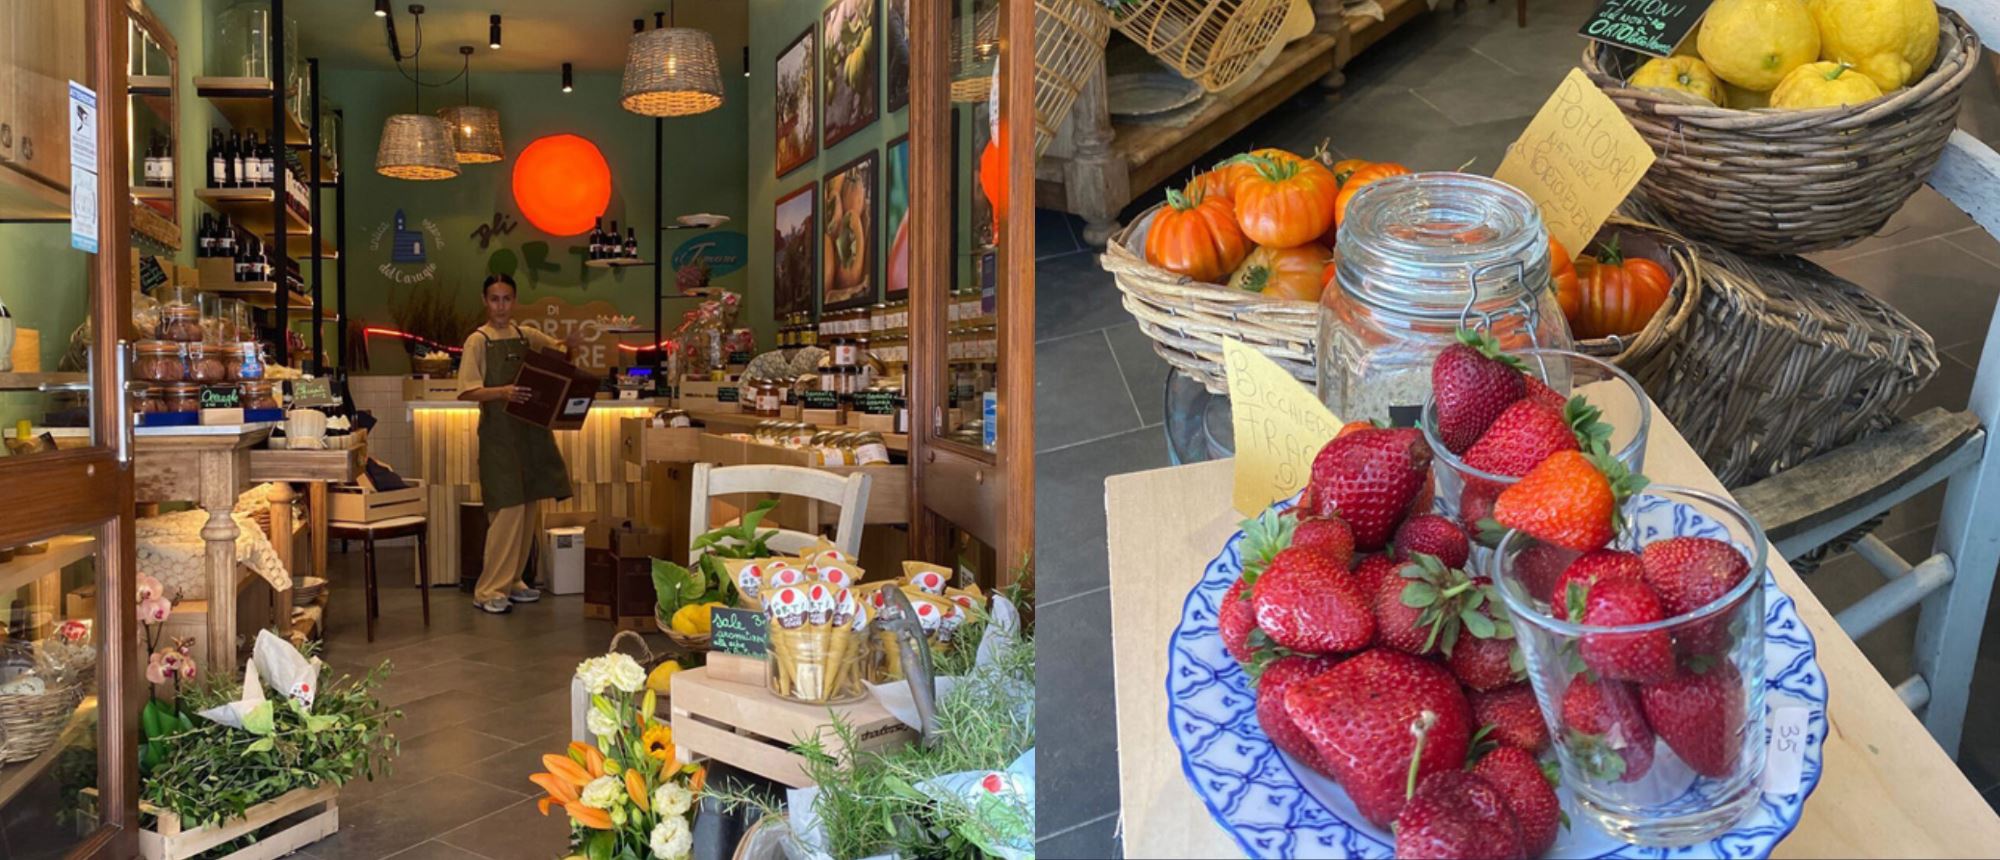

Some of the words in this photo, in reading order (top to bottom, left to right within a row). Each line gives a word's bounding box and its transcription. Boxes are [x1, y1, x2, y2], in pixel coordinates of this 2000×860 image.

[471, 212, 518, 249] gli
[547, 305, 560, 315] DI
[712, 612, 747, 630] sale
[1777, 725, 1800, 753] 35
